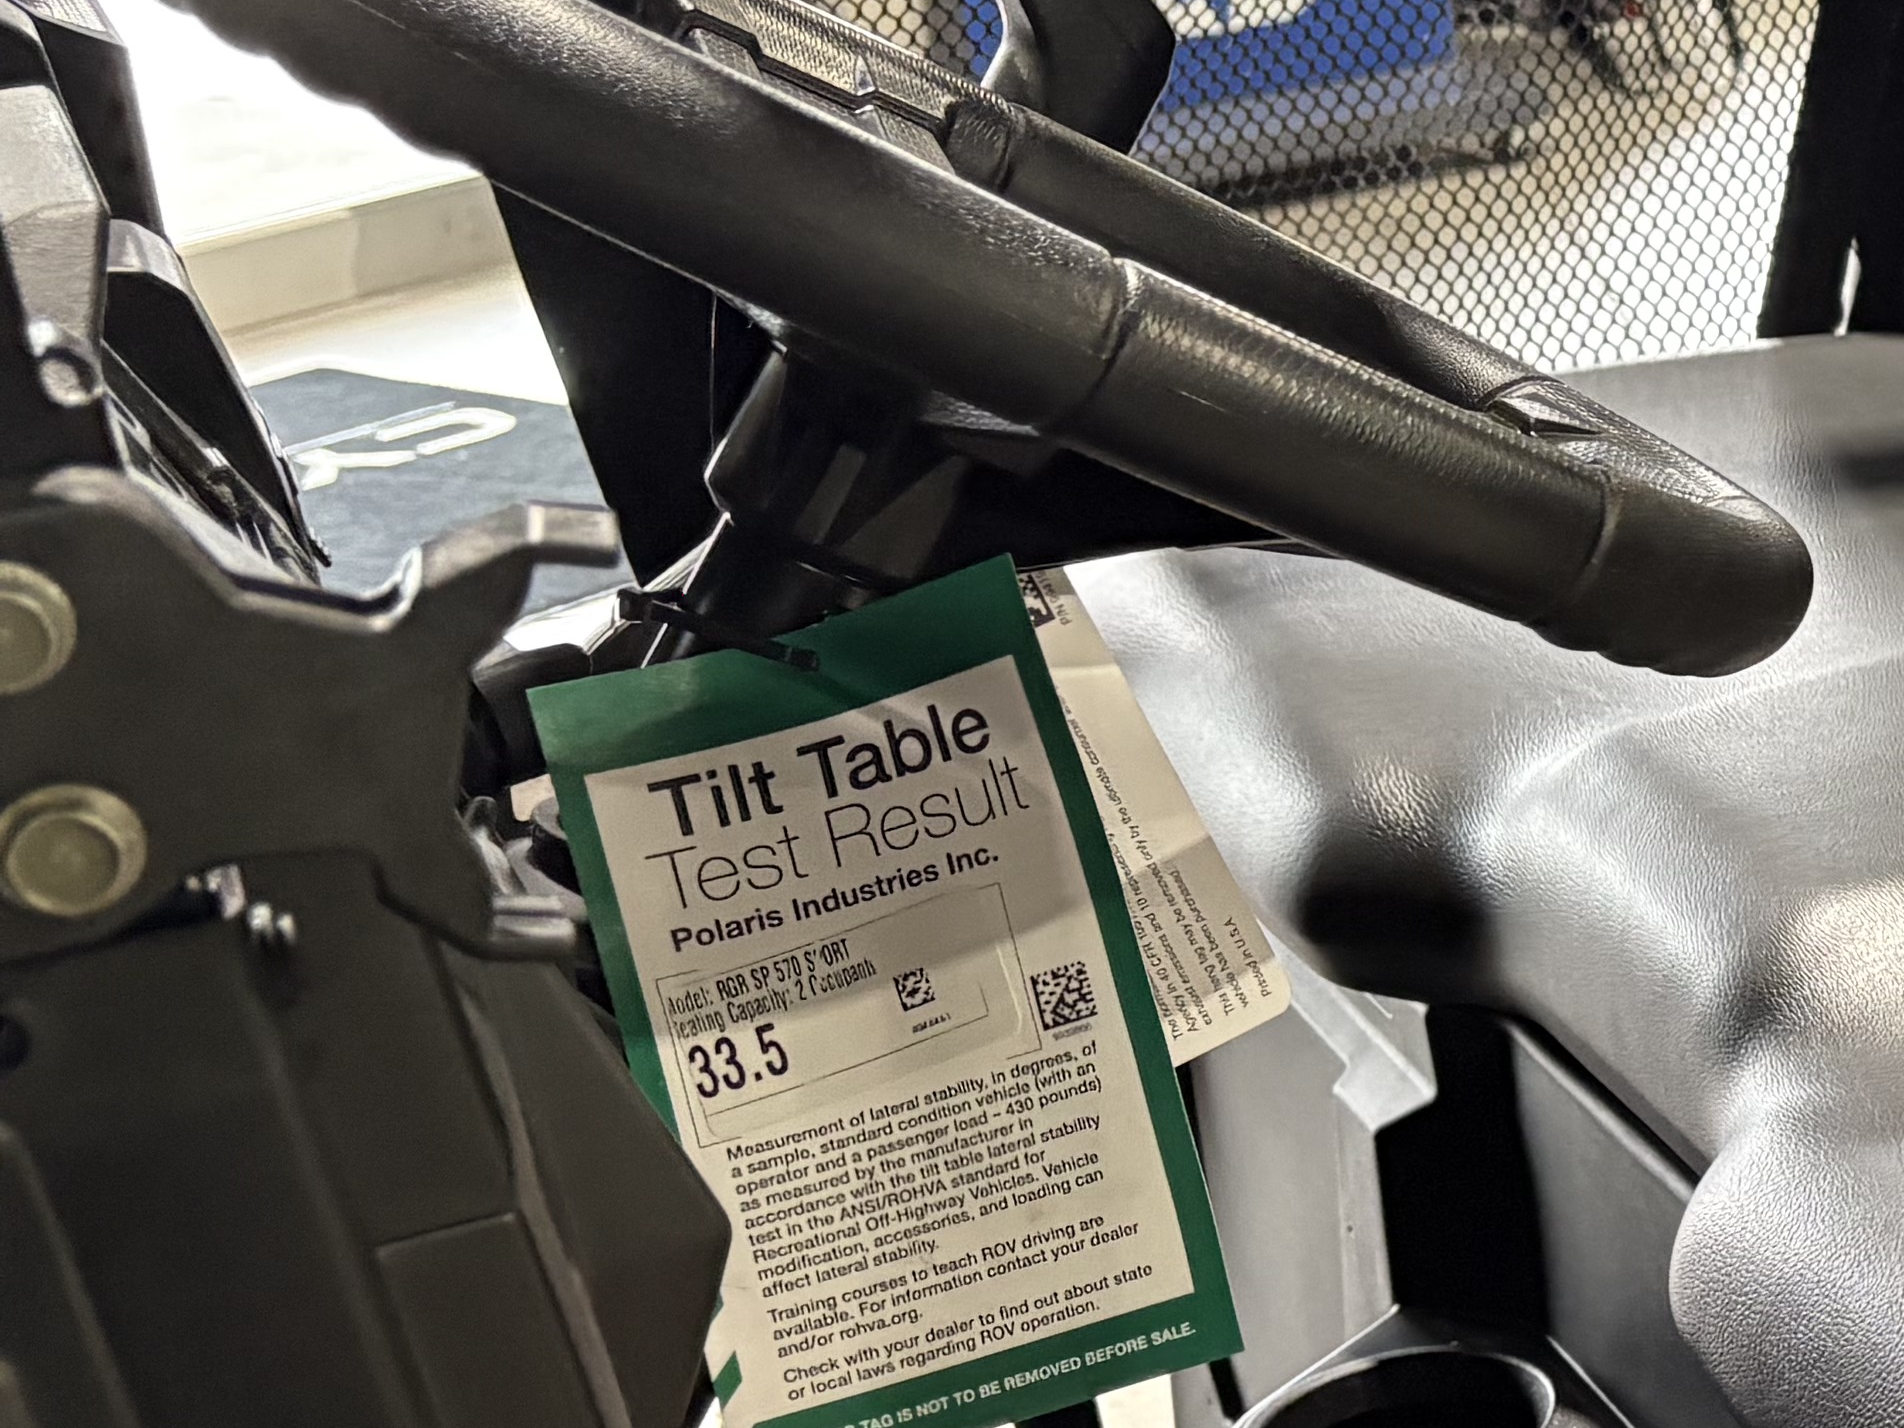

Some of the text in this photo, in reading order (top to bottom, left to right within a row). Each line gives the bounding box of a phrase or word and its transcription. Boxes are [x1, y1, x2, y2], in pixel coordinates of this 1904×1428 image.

[646, 703, 991, 838] Tilt Table
[1117, 806, 1133, 825] the
[643, 755, 1031, 910] Test Result
[669, 847, 999, 953] Polaris Industries Inc.
[1180, 923, 1199, 947] may
[1200, 923, 1220, 953] been
[715, 973, 750, 1002] RGR
[749, 965, 770, 991] SP
[772, 954, 803, 983] 570
[726, 988, 795, 1024] Capacity:
[794, 978, 808, 1002] 2
[1142, 941, 1162, 968] CFR
[1193, 945, 1209, 966] tag
[1203, 963, 1224, 993] hang
[1171, 994, 1202, 1033] Agency
[1218, 992, 1236, 1017] This
[687, 1022, 790, 1103] 33.5
[725, 1039, 1097, 1162] Measurement of lateral stability, in degrees, of
[730, 1062, 1097, 1179] a sample, standard condition vehicle (with an
[734, 1165, 810, 1197] operator
[814, 1151, 848, 1174] and
[851, 1151, 863, 1164] a
[866, 1124, 950, 1162] passenger
[953, 1109, 989, 1133] load
[1005, 1096, 1035, 1116] 430
[1038, 1075, 1102, 1111] pounds)
[739, 1117, 1034, 1214] as measured by the manufacturer in
[744, 1114, 1100, 1231] accordance with the tilt table lateral stability
[747, 1149, 1046, 1247] test in the ANSI/ROHVA standard for
[752, 1152, 1099, 1265] Recreational Off-Highway Vehicles. Vehicle
[757, 1169, 1104, 1282] modification, accessories, and loading can
[761, 1239, 940, 1299] affect lateral stability.
[766, 1215, 1105, 1324] Training courses to teach ROV driving are
[773, 1222, 1139, 1342] available. For information contact your dealer
[783, 1264, 1153, 1384] Check with your dealer to find out about state
[777, 1308, 924, 1359] and/or rohva.org.
[787, 1300, 1101, 1402] or local laws regarding ROV operation.
[896, 1407, 914, 1424] IS
[915, 1396, 950, 1418] NOT
[952, 1388, 976, 1407] TO
[978, 1379, 1002, 1399] BE
[1003, 1356, 1082, 1391] REMOVED
[1084, 1334, 1149, 1367] BEFORE
[1150, 1321, 1197, 1346] SALE.
